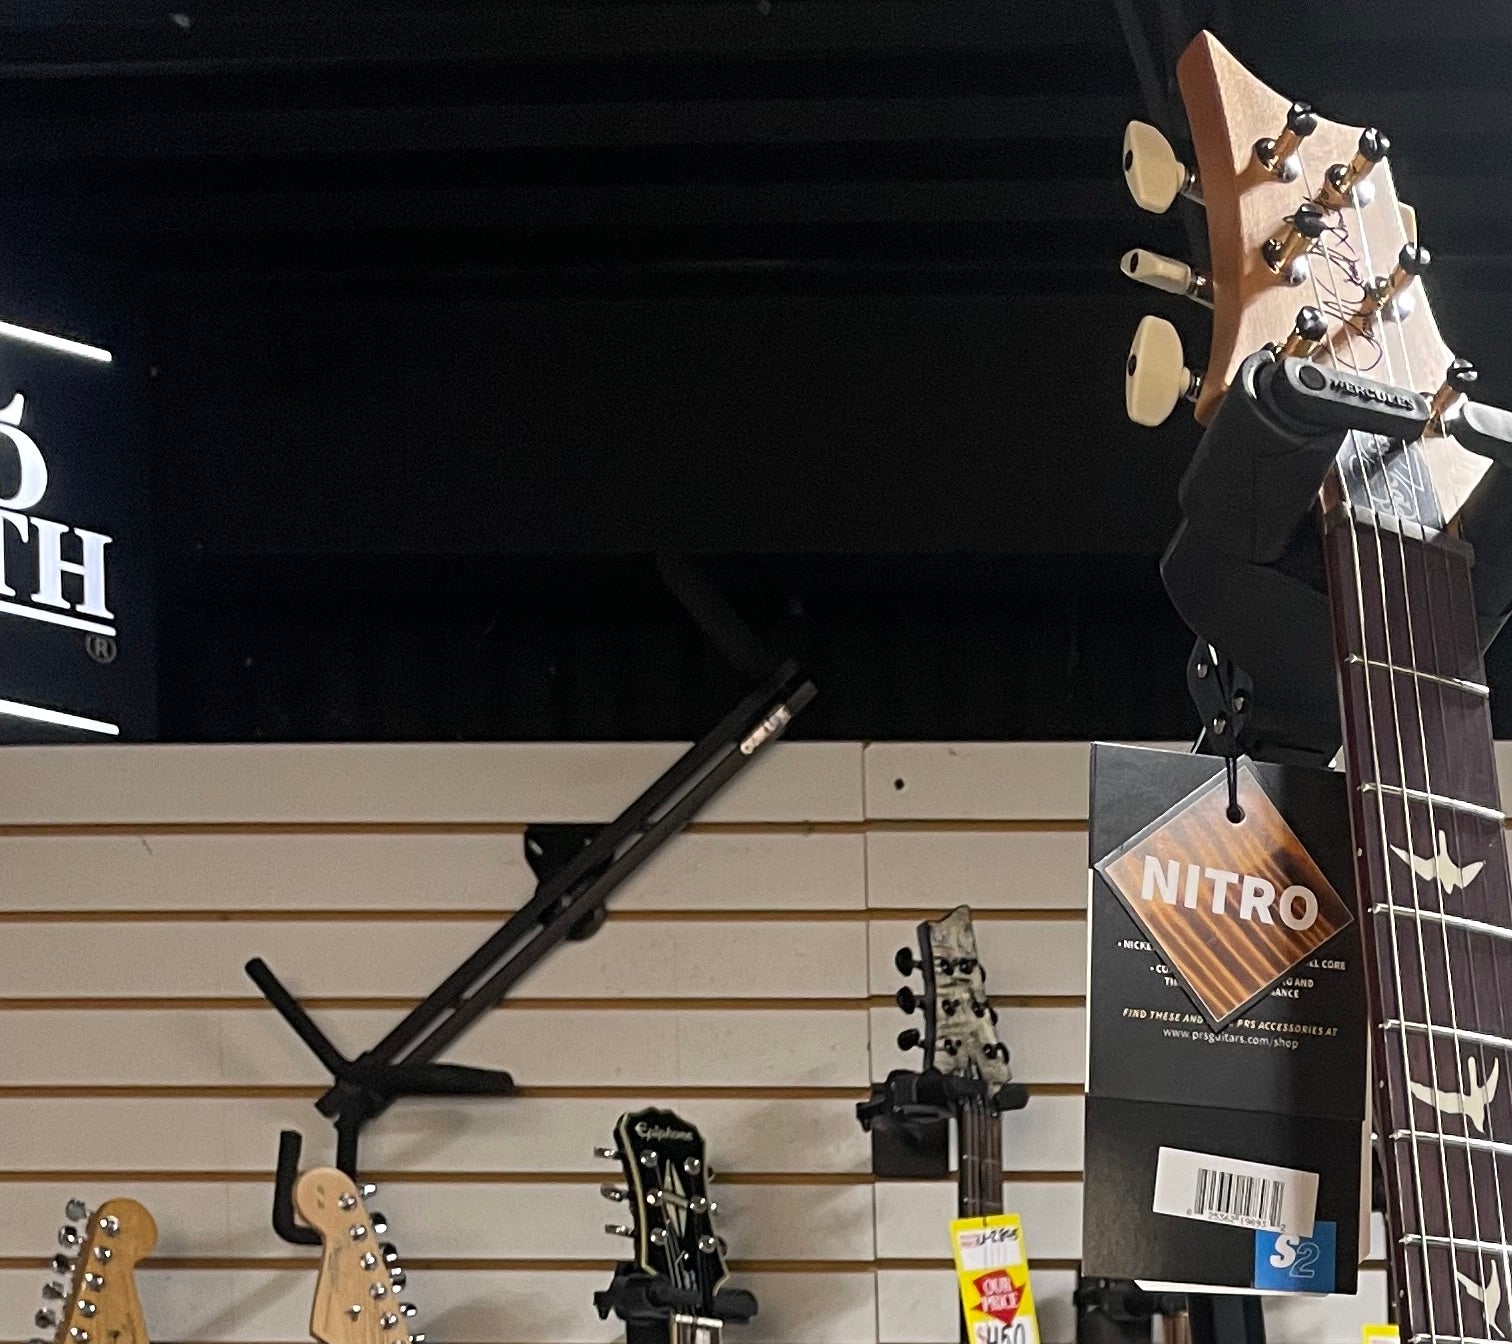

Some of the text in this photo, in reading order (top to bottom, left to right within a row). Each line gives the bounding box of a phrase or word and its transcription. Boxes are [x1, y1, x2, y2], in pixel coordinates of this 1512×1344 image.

[1140, 855, 1319, 931] NITRO
[1321, 960, 1346, 971] CORE
[1294, 978, 1314, 988] AND
[1122, 1008, 1338, 1036] FIND THESE AND PRS ACCESSORIES AT
[1270, 1234, 1320, 1278] S2
